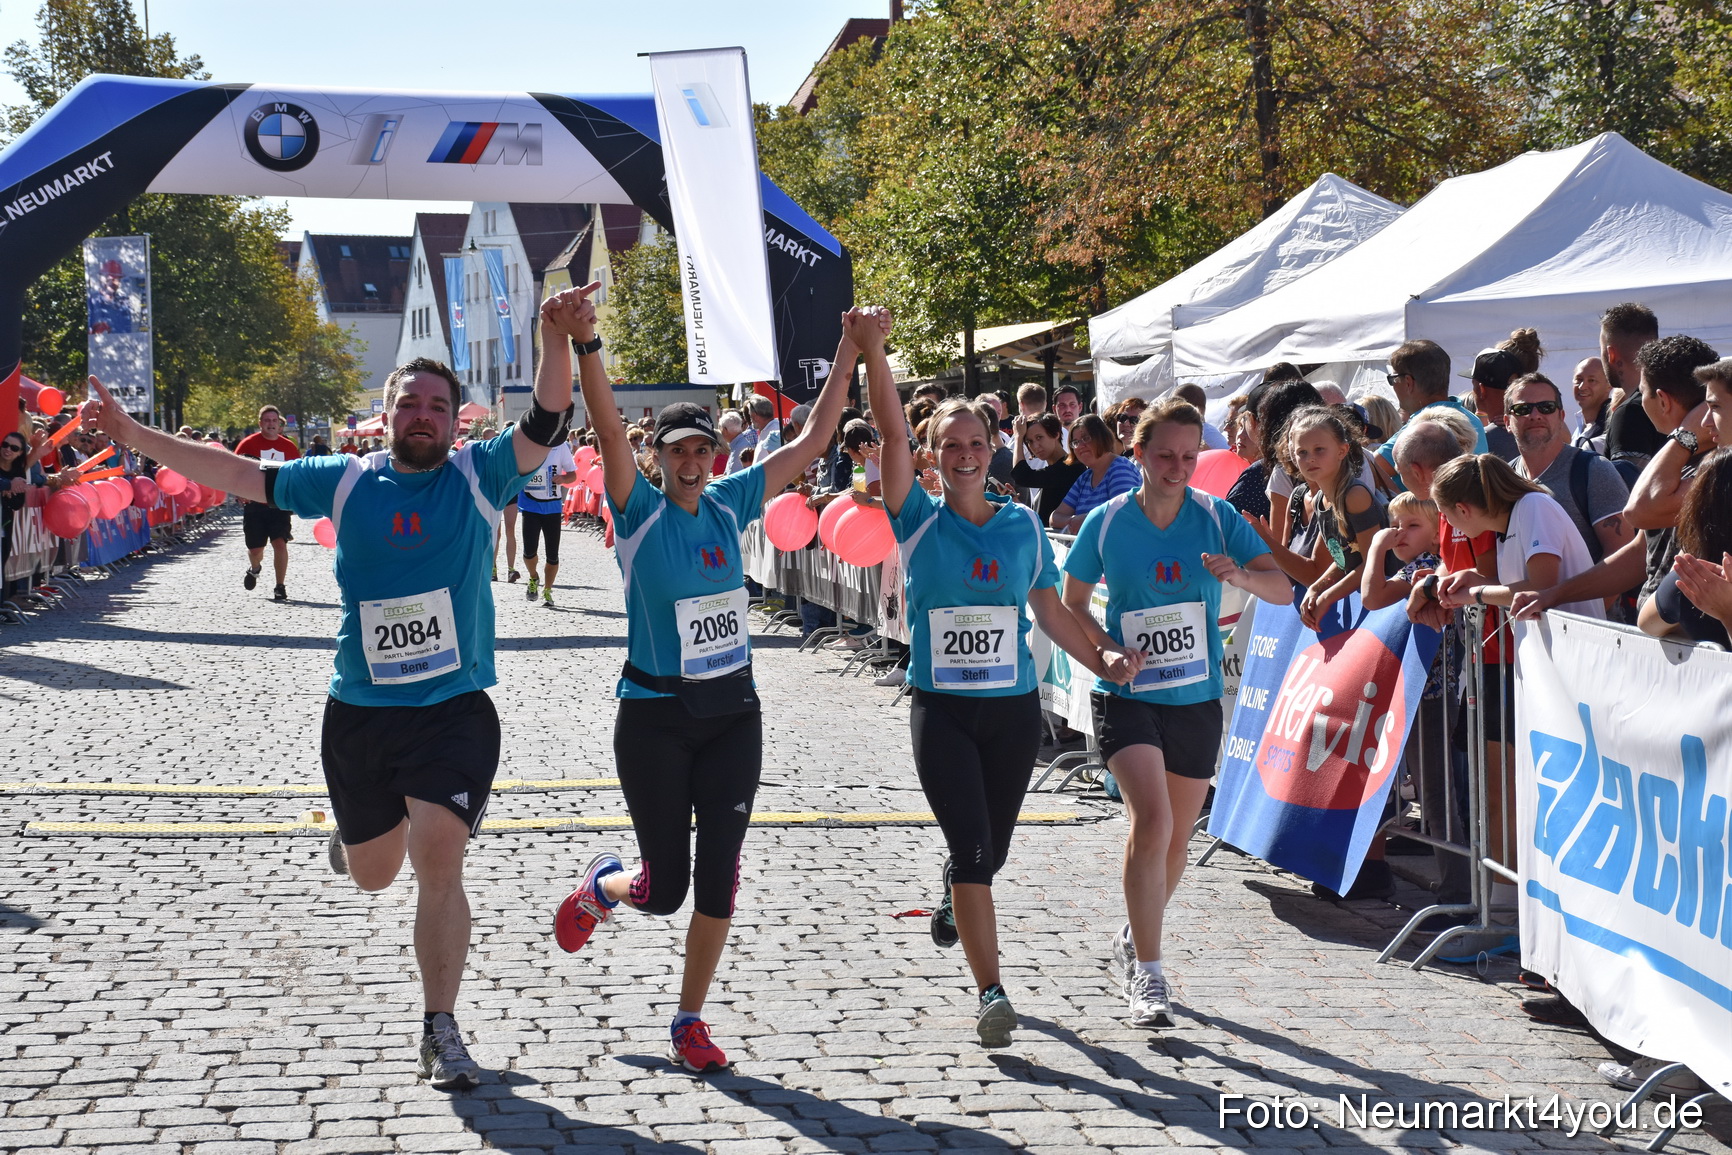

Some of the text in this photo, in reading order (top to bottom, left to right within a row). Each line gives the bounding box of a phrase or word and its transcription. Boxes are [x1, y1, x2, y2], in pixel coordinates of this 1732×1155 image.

[250, 103, 312, 124] BMW
[4, 150, 114, 220] NEUMARKT
[764, 223, 822, 267] MARKT
[383, 602, 427, 618] BOCK
[698, 597, 730, 612] BOCK
[689, 610, 739, 646] 2086
[954, 613, 992, 624] BOCK
[1144, 611, 1183, 626] BOCK
[374, 615, 442, 651] 2084
[943, 629, 1005, 655] 2087
[1136, 625, 1196, 657] 2085
[405, 647, 433, 657] Neumarkt
[699, 641, 734, 654] PARTL Neumarkt
[1250, 634, 1279, 659] STORE
[400, 660, 429, 674] Bene
[1145, 655, 1189, 666] PARTL Neumarkt
[962, 669, 990, 680] Steffi
[1159, 666, 1186, 680] Kathi
[1239, 685, 1270, 711] NLINE
[1266, 653, 1396, 774] Hervis
[1227, 735, 1256, 762] OBILE
[1263, 744, 1296, 773] SPORTS
